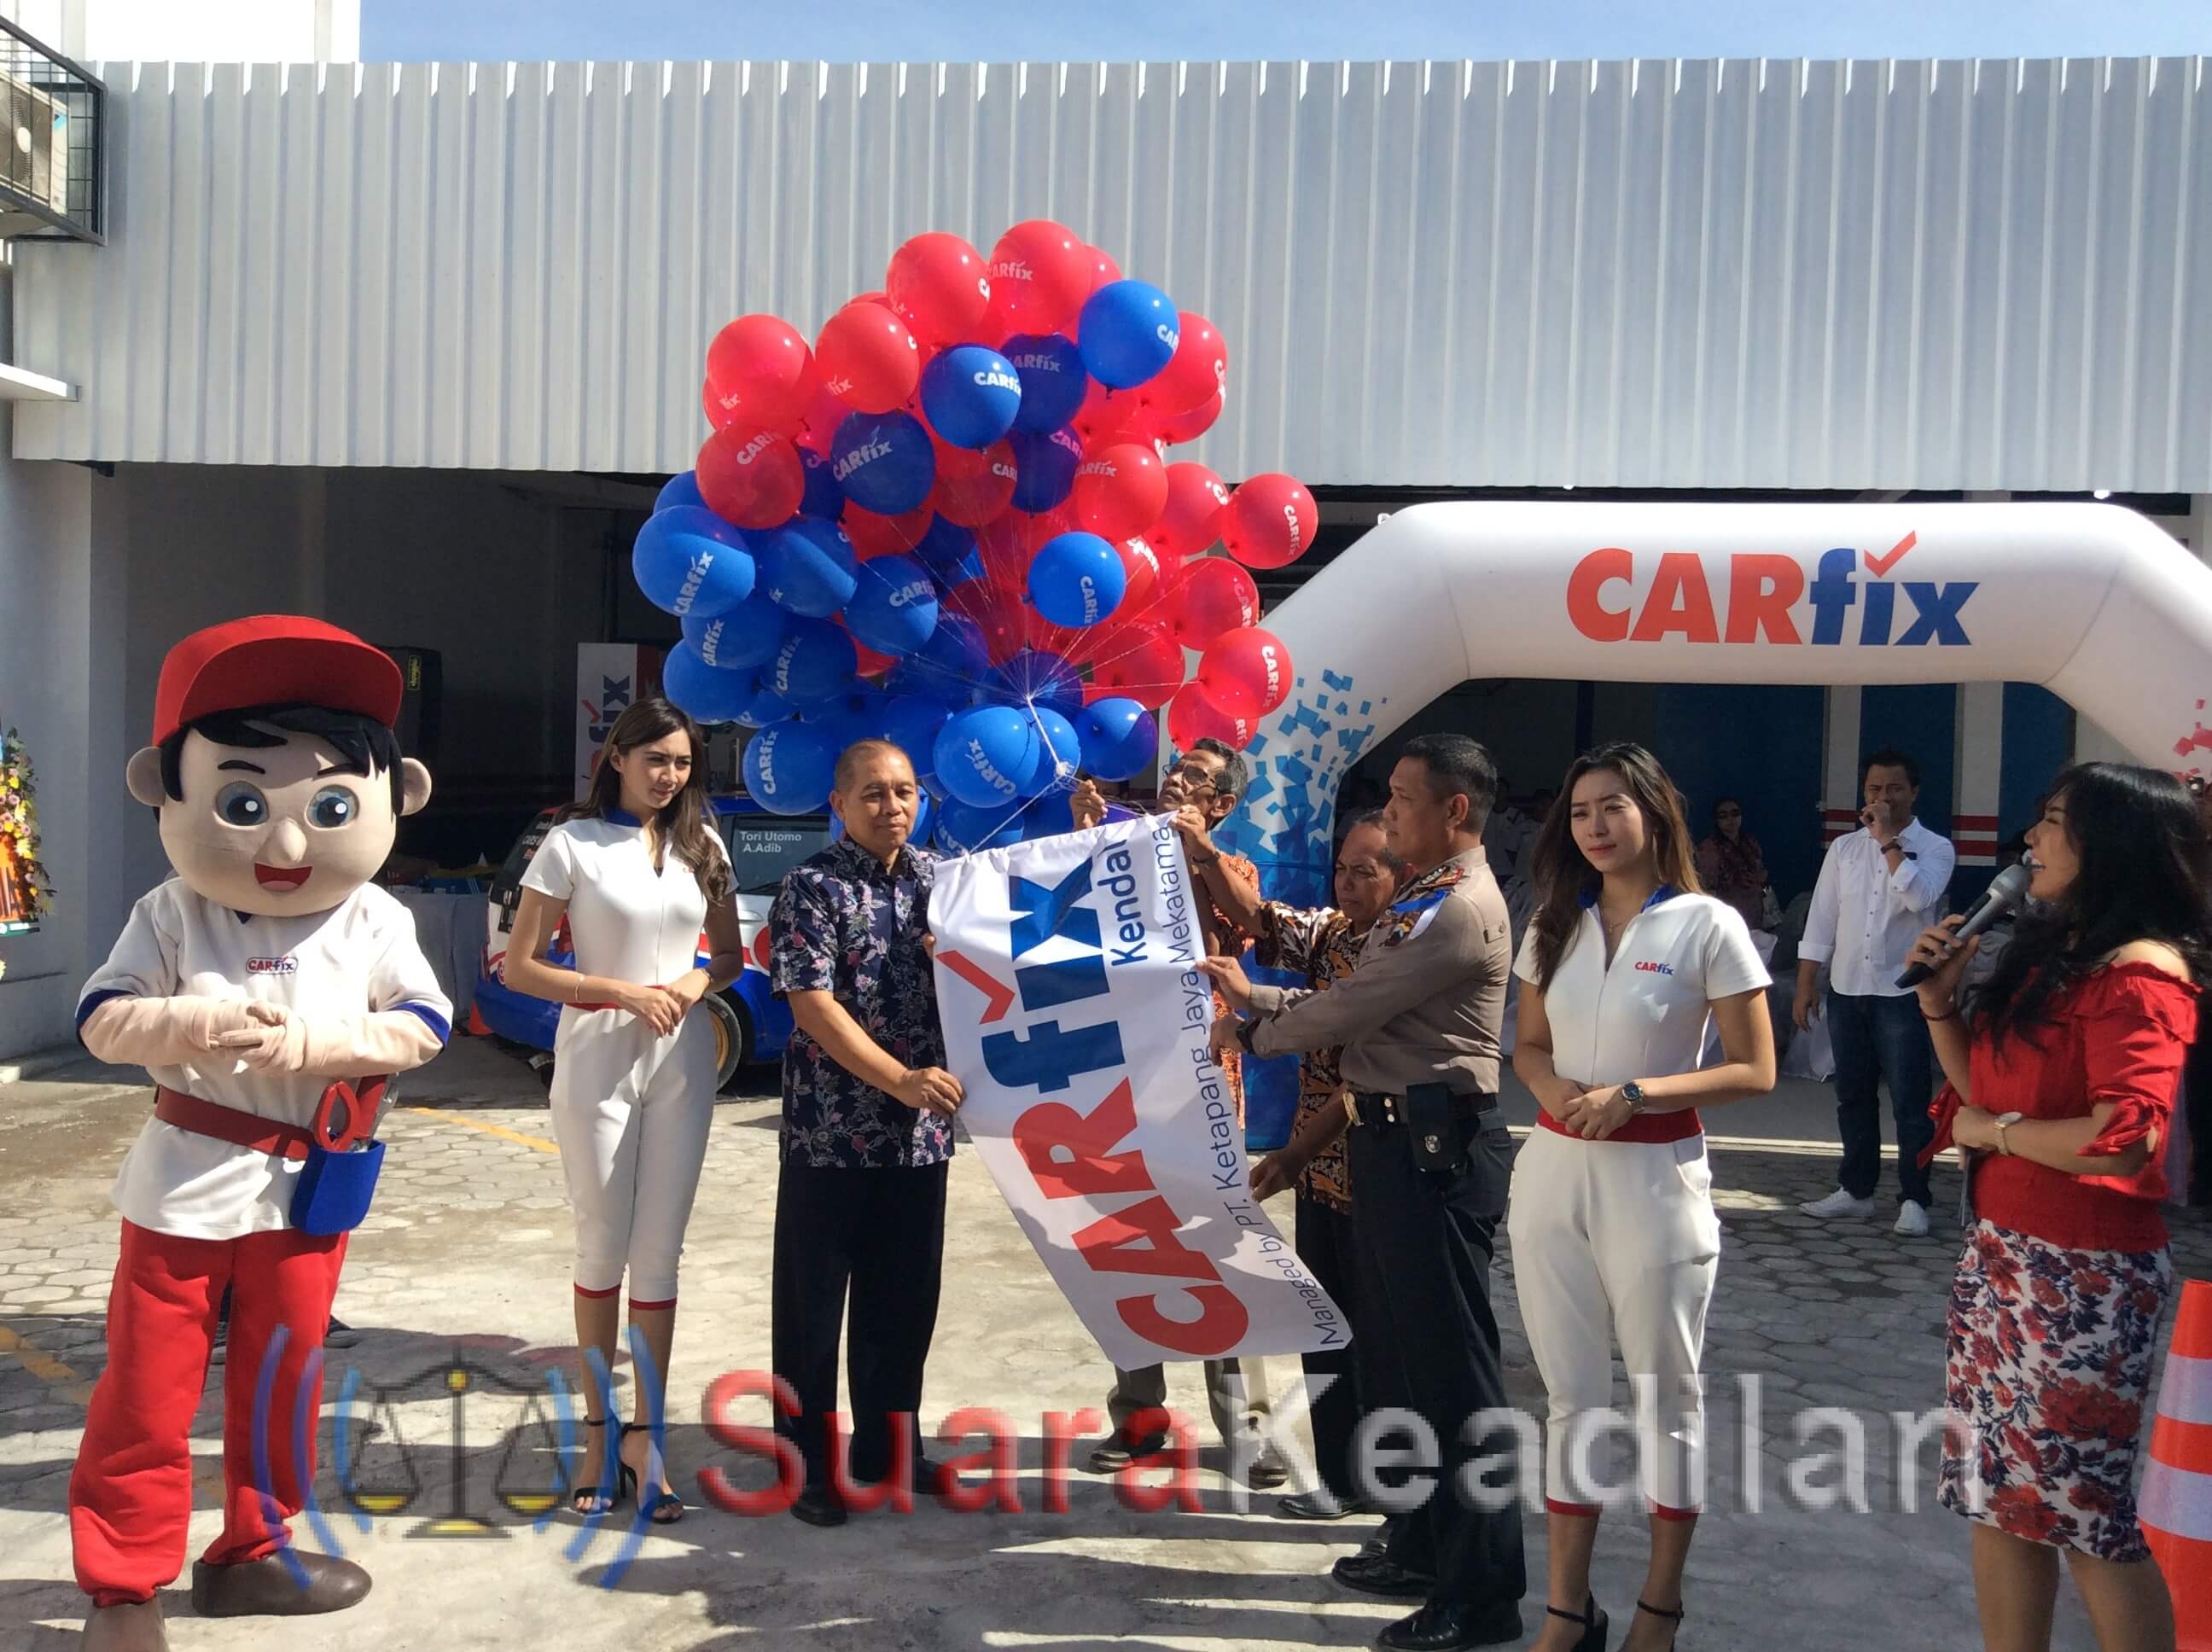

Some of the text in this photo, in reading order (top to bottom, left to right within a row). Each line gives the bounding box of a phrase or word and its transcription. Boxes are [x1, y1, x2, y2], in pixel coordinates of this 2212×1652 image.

[988, 260, 1033, 281] ARfix
[1009, 354, 1061, 373] ARfix
[832, 425, 893, 482] CARfix
[673, 550, 714, 614] CARfix
[1567, 530, 1980, 646] CARfix
[701, 619, 725, 667] CARfix
[759, 730, 779, 795] CARfix
[964, 737, 1016, 795] CARfix
[740, 831, 802, 841] Tori Utomo
[742, 843, 782, 853] A.Adib
[248, 956, 294, 971] CARfix
[1634, 961, 1674, 975] CARfix
[935, 858, 1249, 1355] CARfix
[1152, 826, 1344, 1345] Managed by PT. Ketapang Jaya Mekatama
